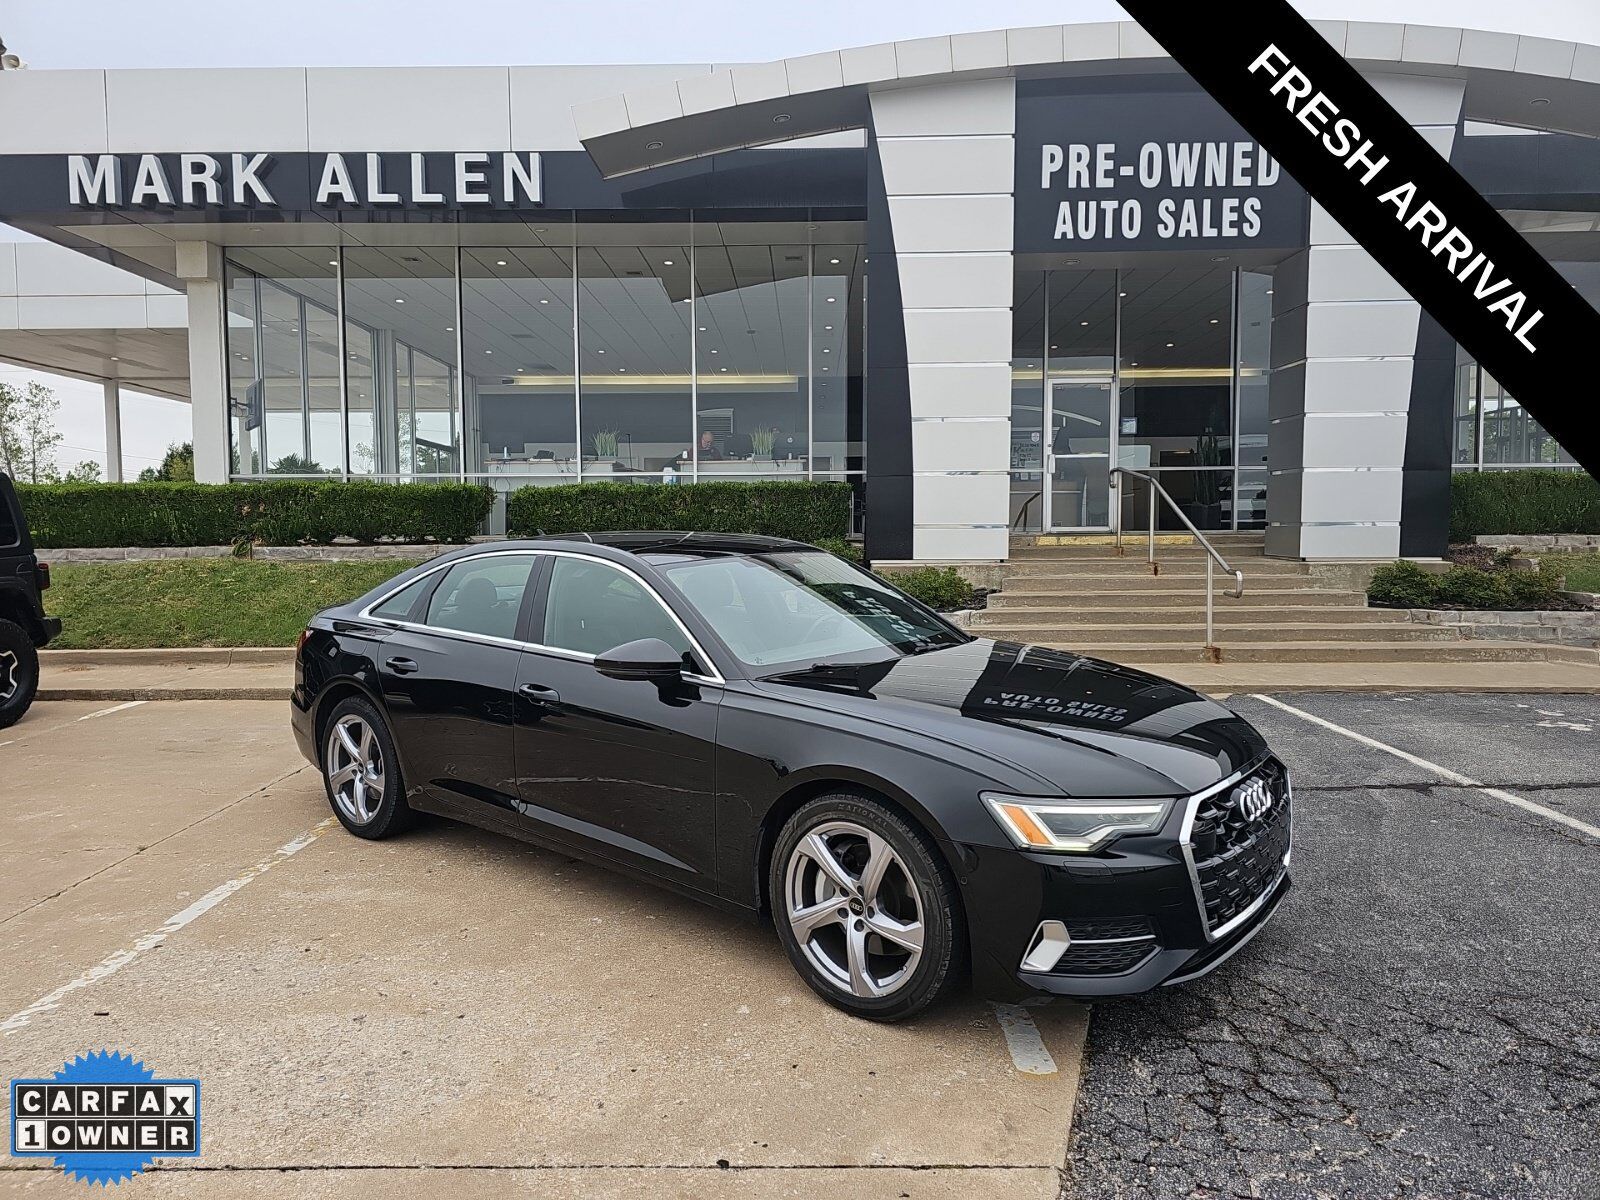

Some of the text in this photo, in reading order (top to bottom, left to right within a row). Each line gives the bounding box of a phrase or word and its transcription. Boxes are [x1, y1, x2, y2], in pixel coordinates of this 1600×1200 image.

[68, 152, 543, 206] MARK ALLEN
[1041, 142, 1280, 189] PRE-OWNED
[1054, 197, 1262, 240] AUTO SALES
